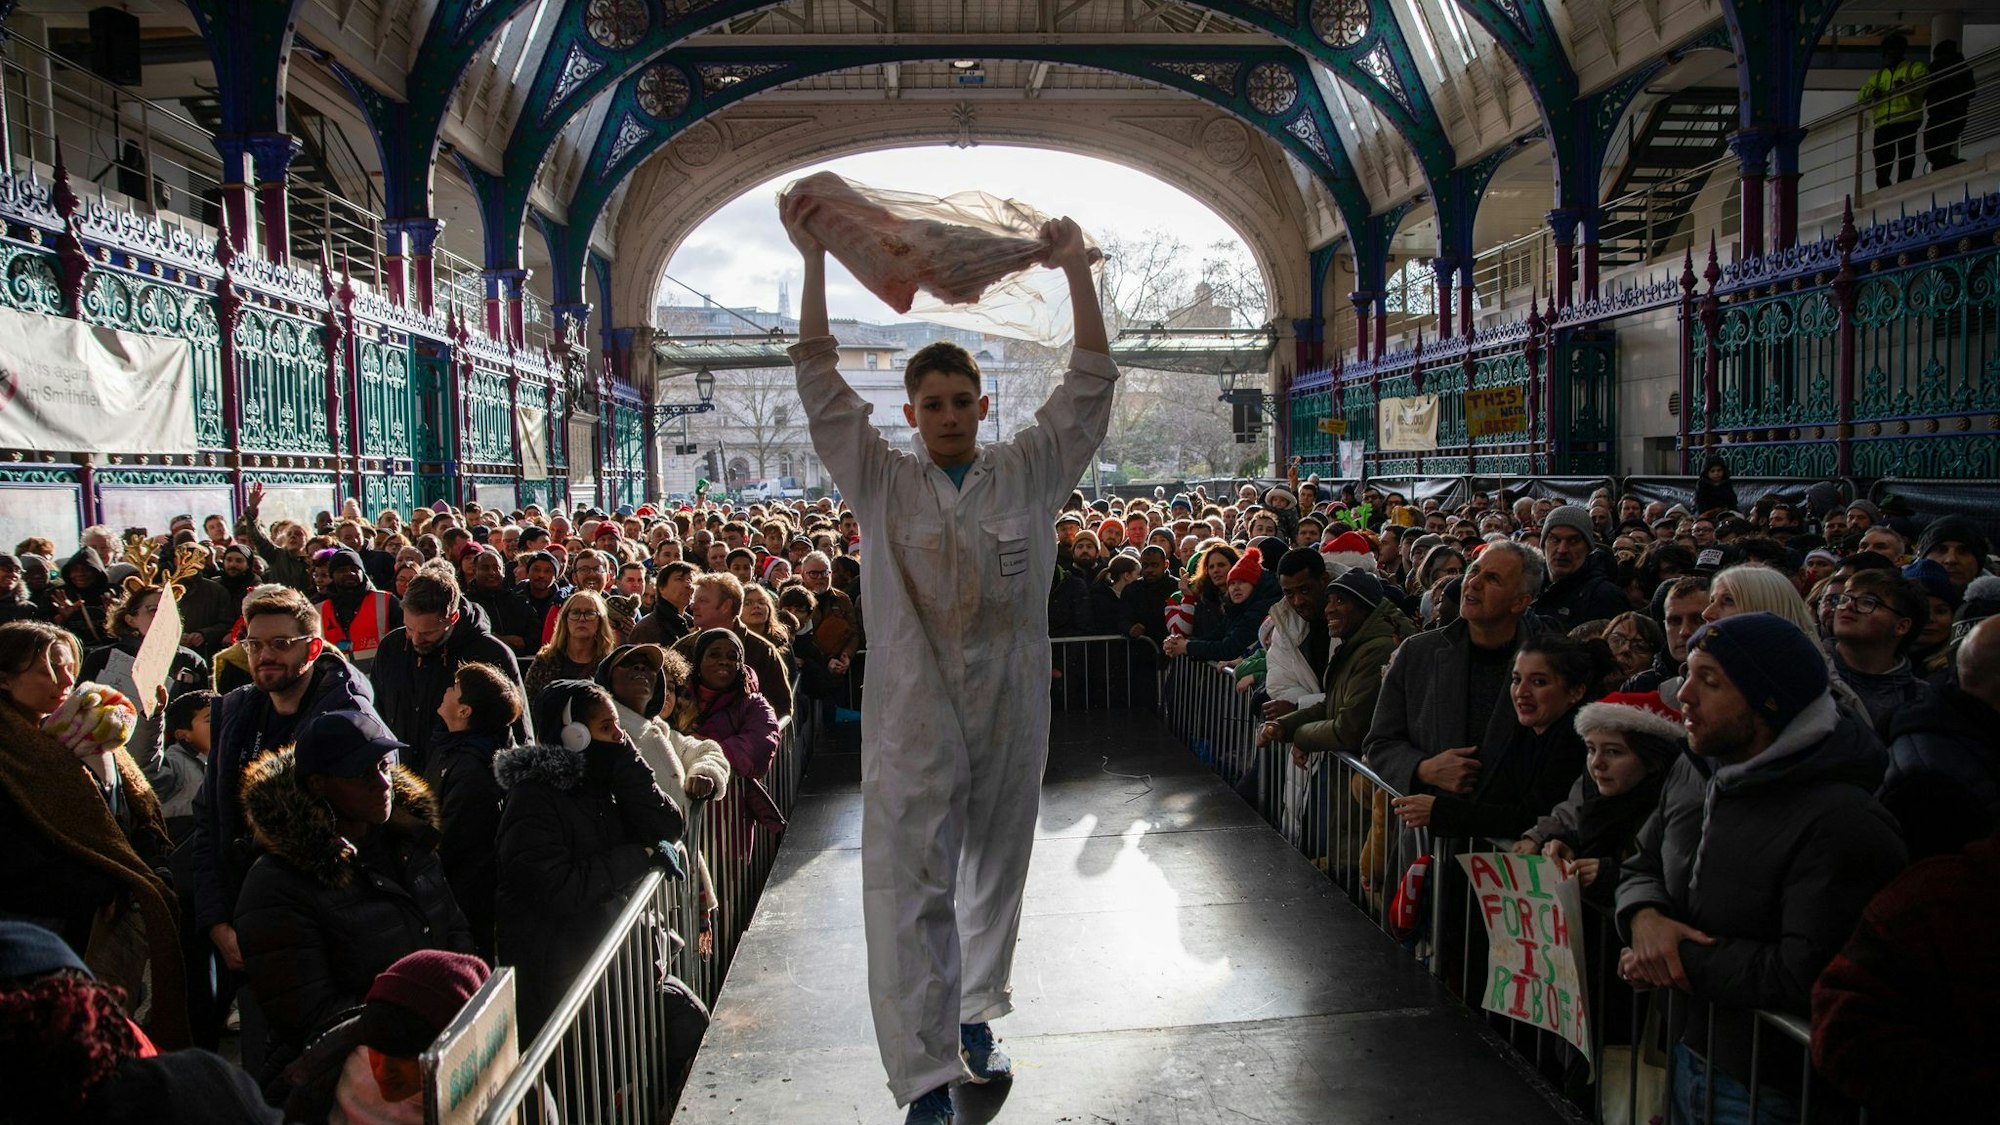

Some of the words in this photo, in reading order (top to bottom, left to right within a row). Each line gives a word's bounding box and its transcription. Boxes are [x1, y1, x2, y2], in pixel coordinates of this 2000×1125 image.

[25, 383, 39, 401] in
[43, 385, 101, 406] Smithfie
[1467, 390, 1517, 409] THIS
[1481, 894, 1535, 939] FOR
[1538, 903, 1569, 949] CH
[1516, 938, 1556, 985] IS
